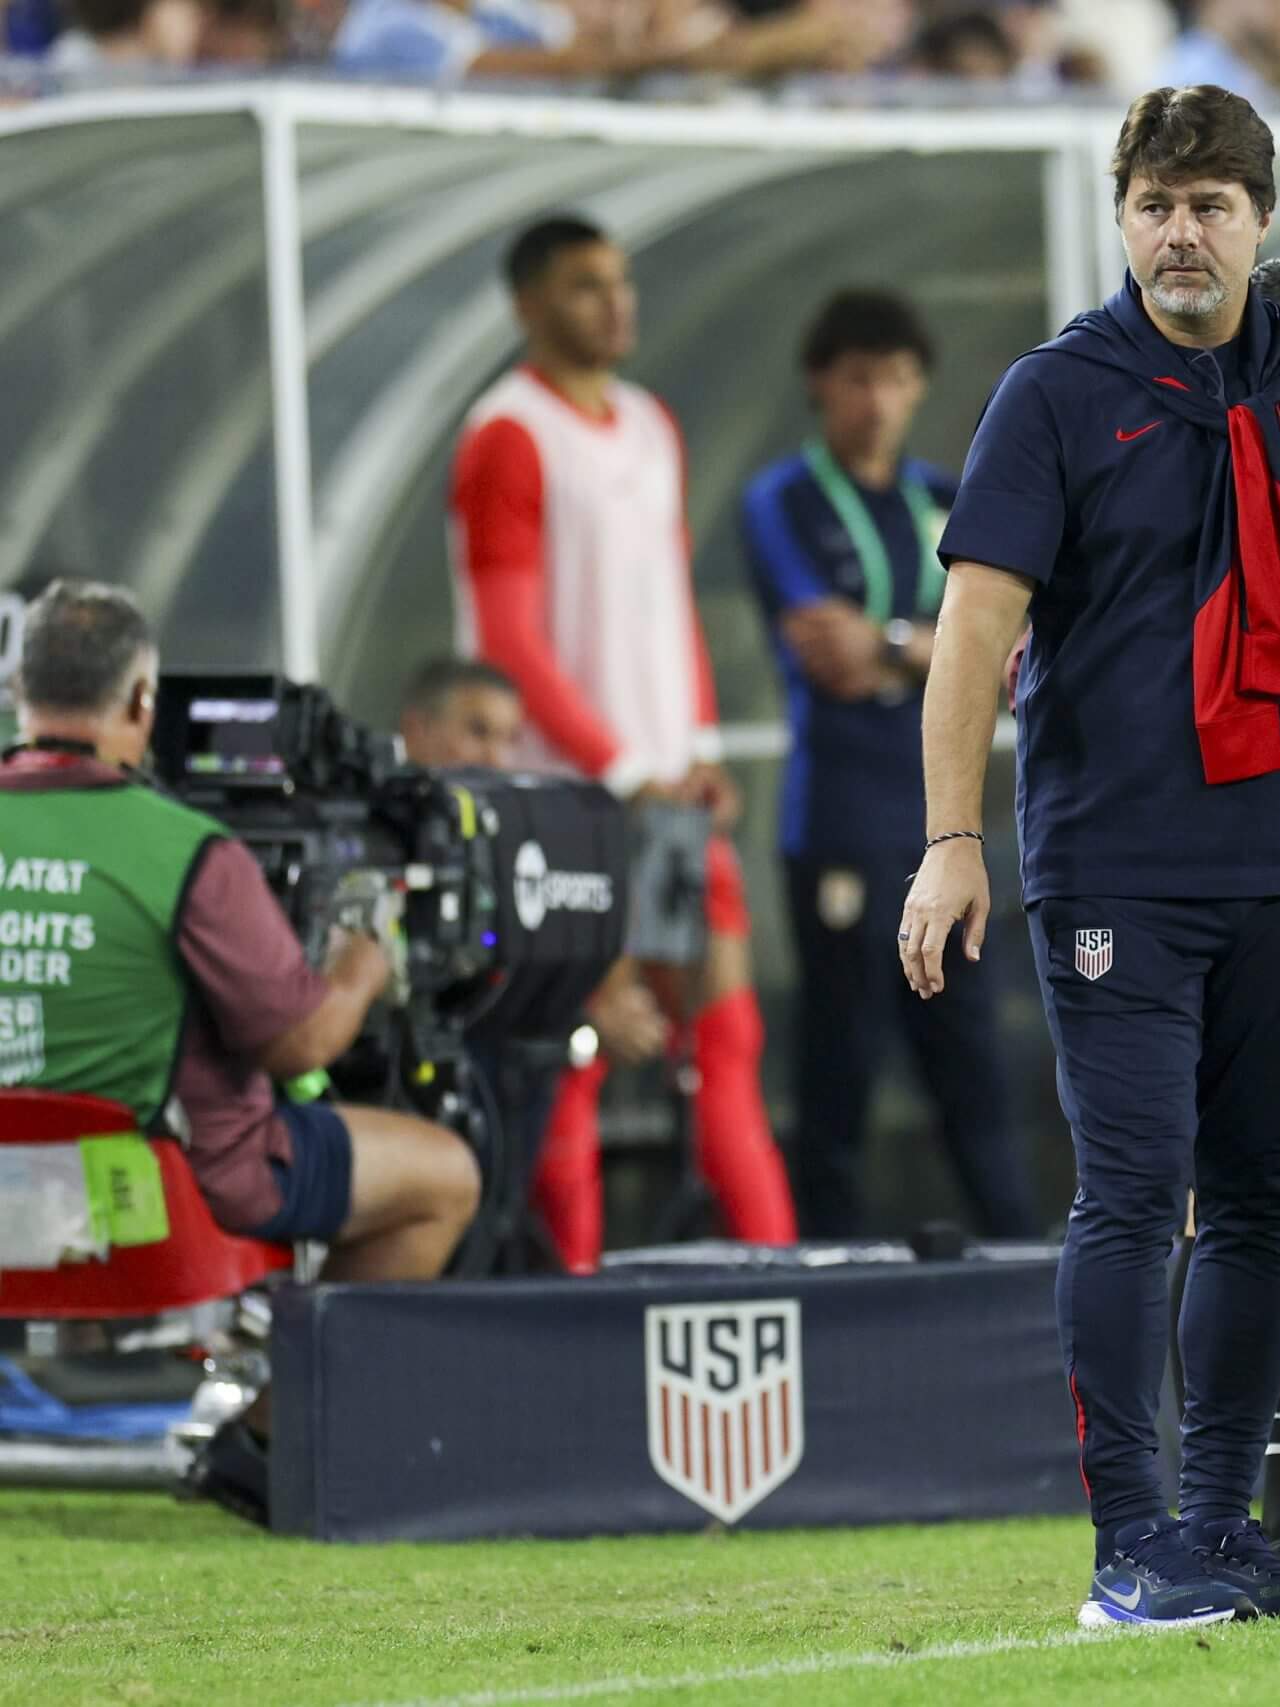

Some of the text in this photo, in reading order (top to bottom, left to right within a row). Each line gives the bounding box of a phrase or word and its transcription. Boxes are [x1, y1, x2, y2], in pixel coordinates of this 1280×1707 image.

[6, 857, 90, 895] AT&T
[0, 910, 96, 950] GHTS
[1077, 930, 1110, 951] USA
[0, 948, 72, 986] DER
[659, 1315, 787, 1393] USA
